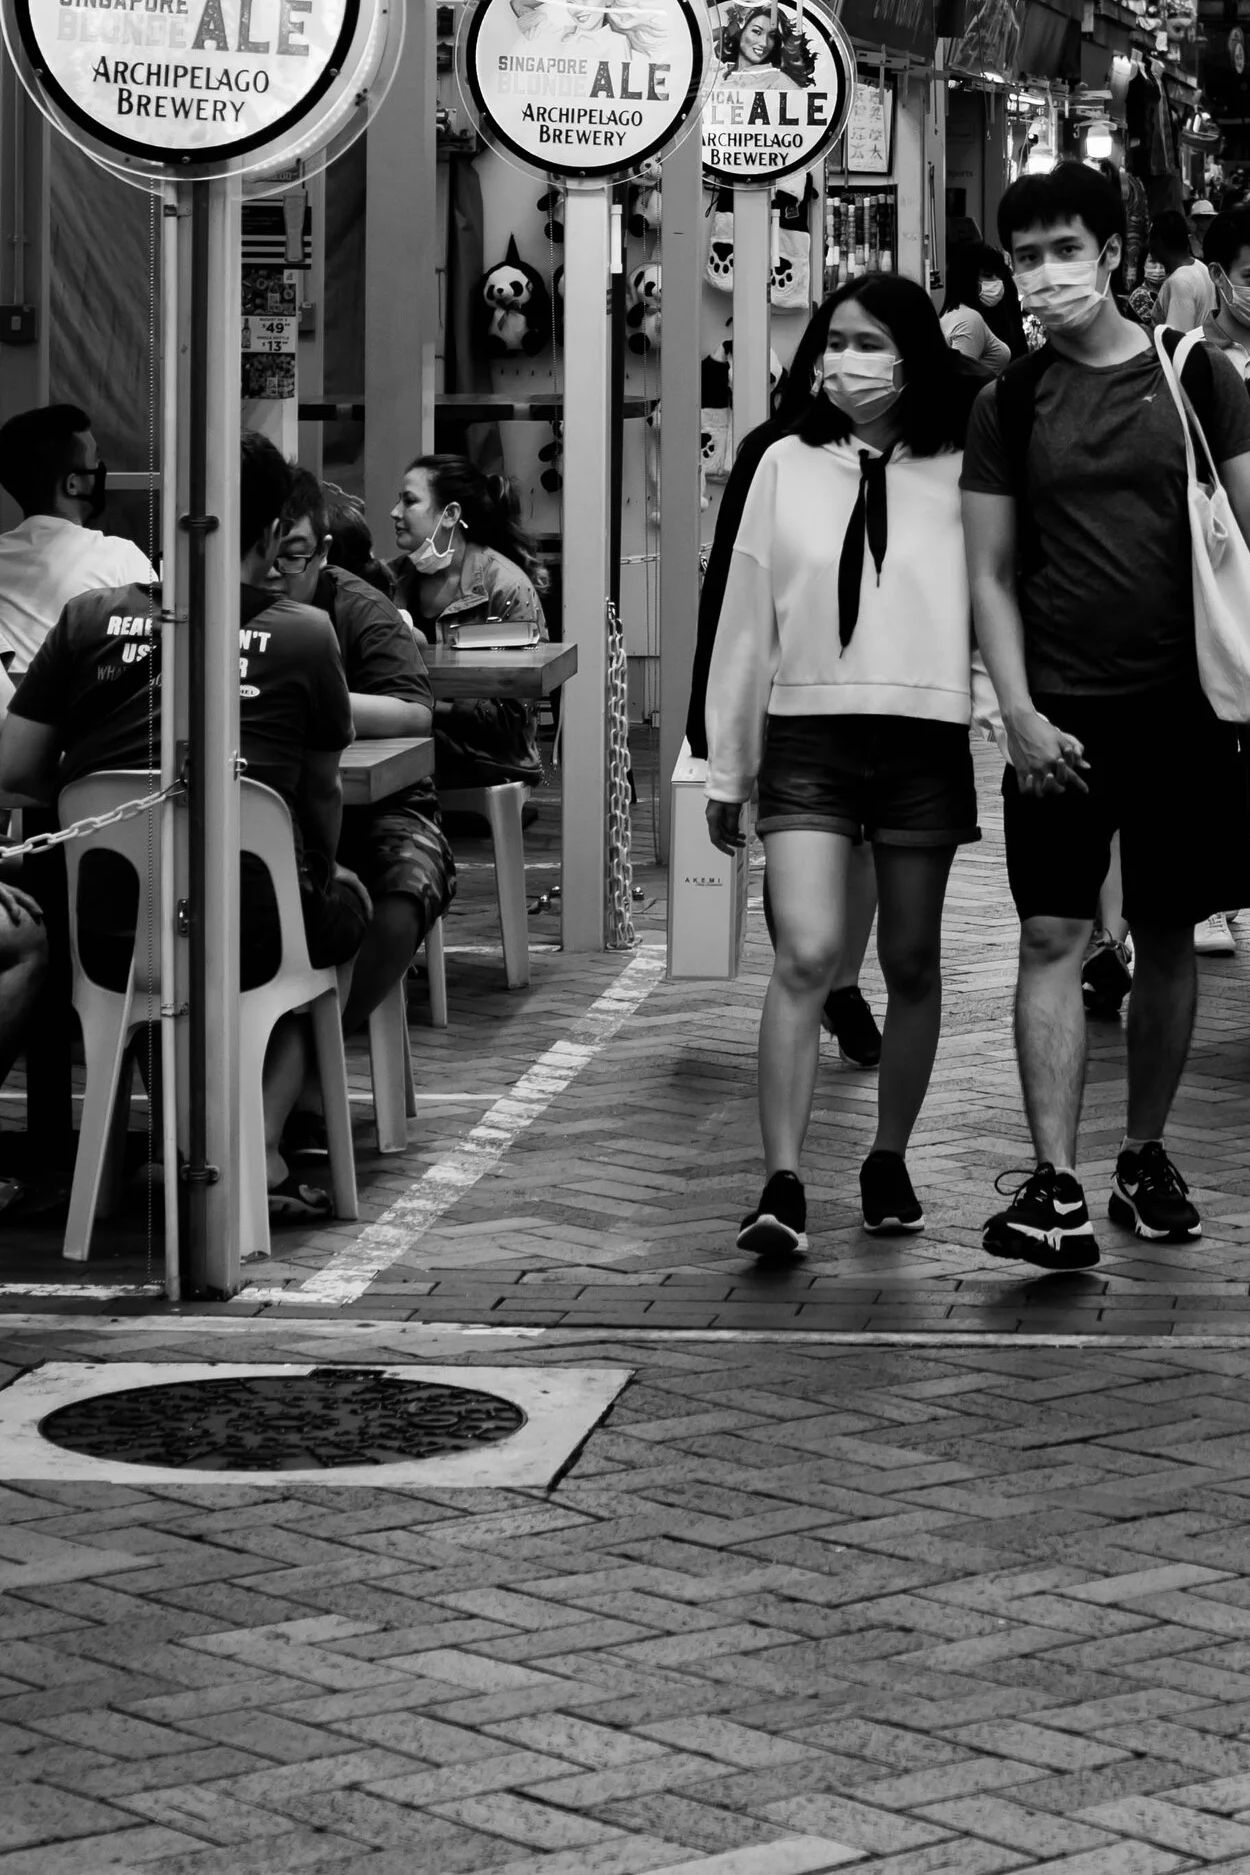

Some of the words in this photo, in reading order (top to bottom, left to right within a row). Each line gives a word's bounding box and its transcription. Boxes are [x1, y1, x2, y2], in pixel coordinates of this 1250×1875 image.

[92, 55, 270, 94] ARCHIPELAGO
[498, 55, 588, 75] SINGAPORE
[589, 61, 671, 101] ALE
[117, 88, 246, 123] BREWERY
[521, 103, 643, 127] ARCHIPELAGO
[711, 105, 744, 125] LE
[748, 92, 827, 126] ALE
[539, 125, 627, 146] BREWERY
[711, 149, 789, 166] BREWERY
